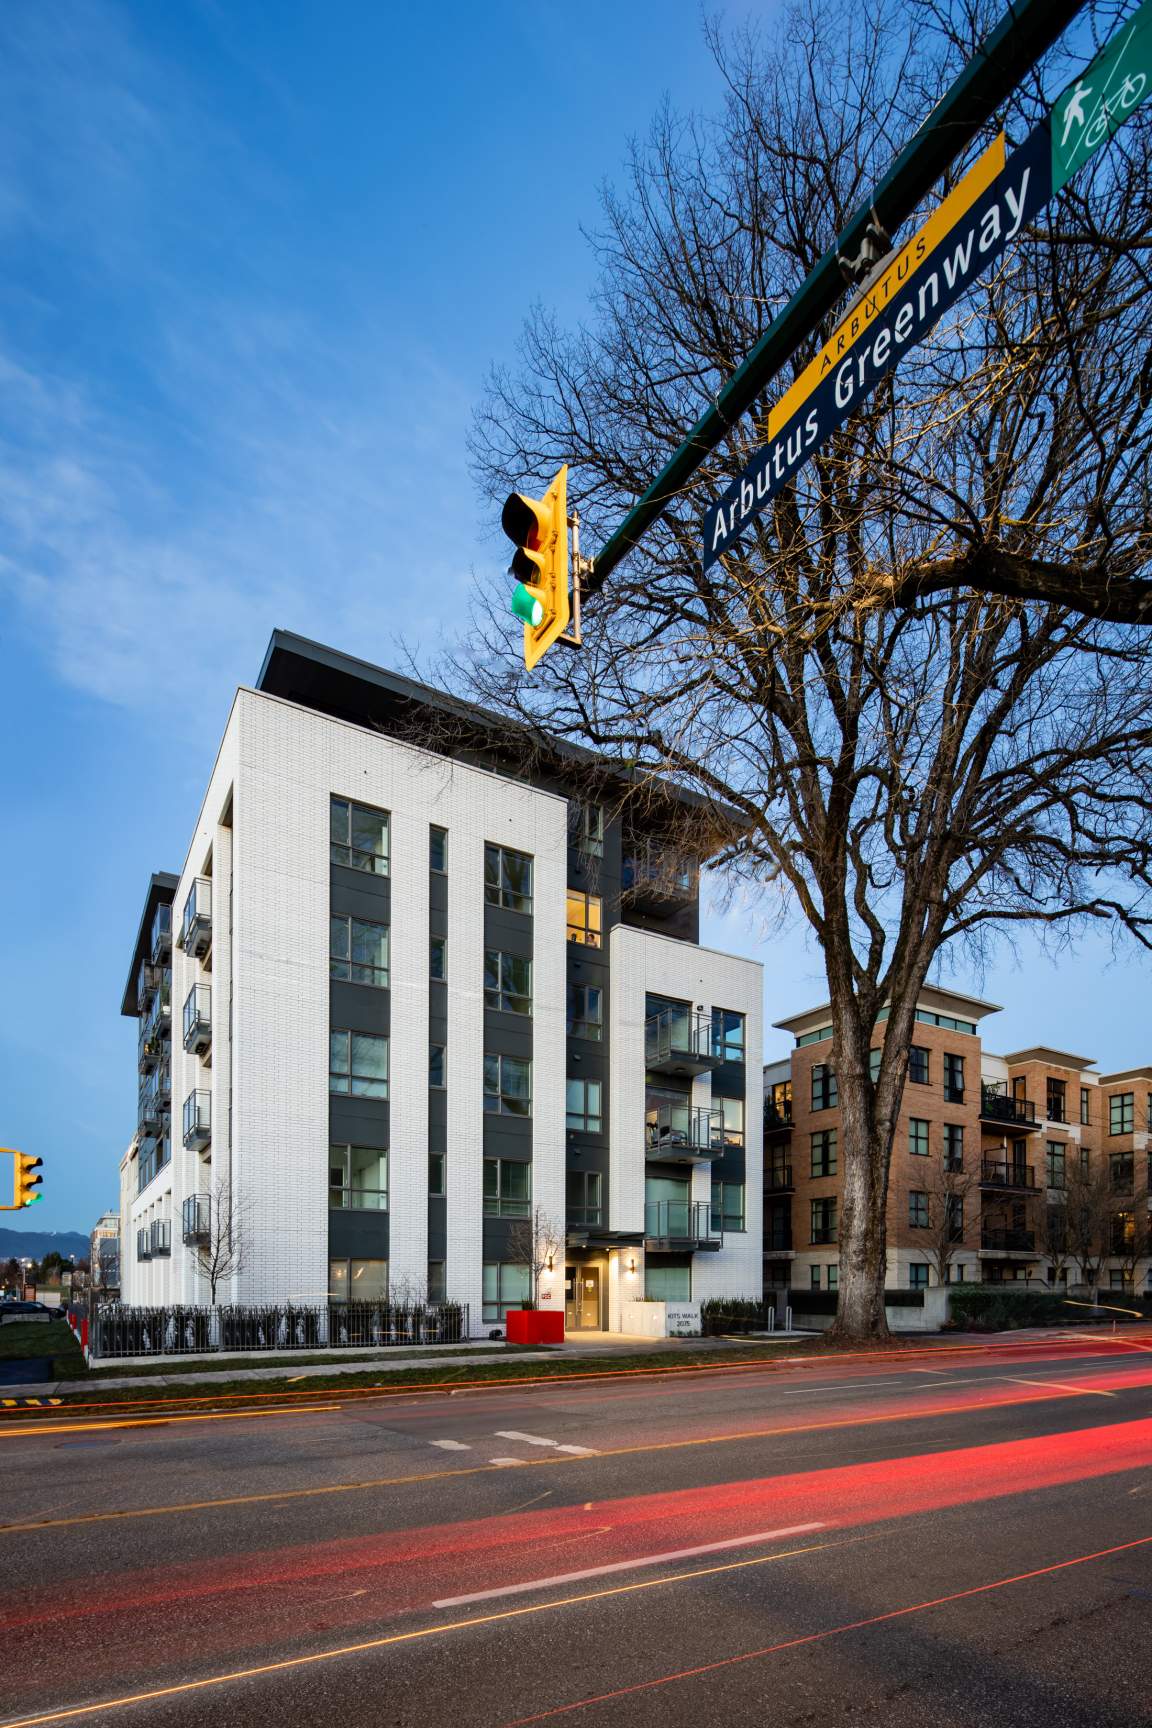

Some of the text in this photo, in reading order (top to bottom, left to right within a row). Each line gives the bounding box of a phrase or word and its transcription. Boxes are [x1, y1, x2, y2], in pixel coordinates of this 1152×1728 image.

[712, 167, 1031, 552] Arbutus Greenway
[820, 237, 925, 375] ARBUTUS
